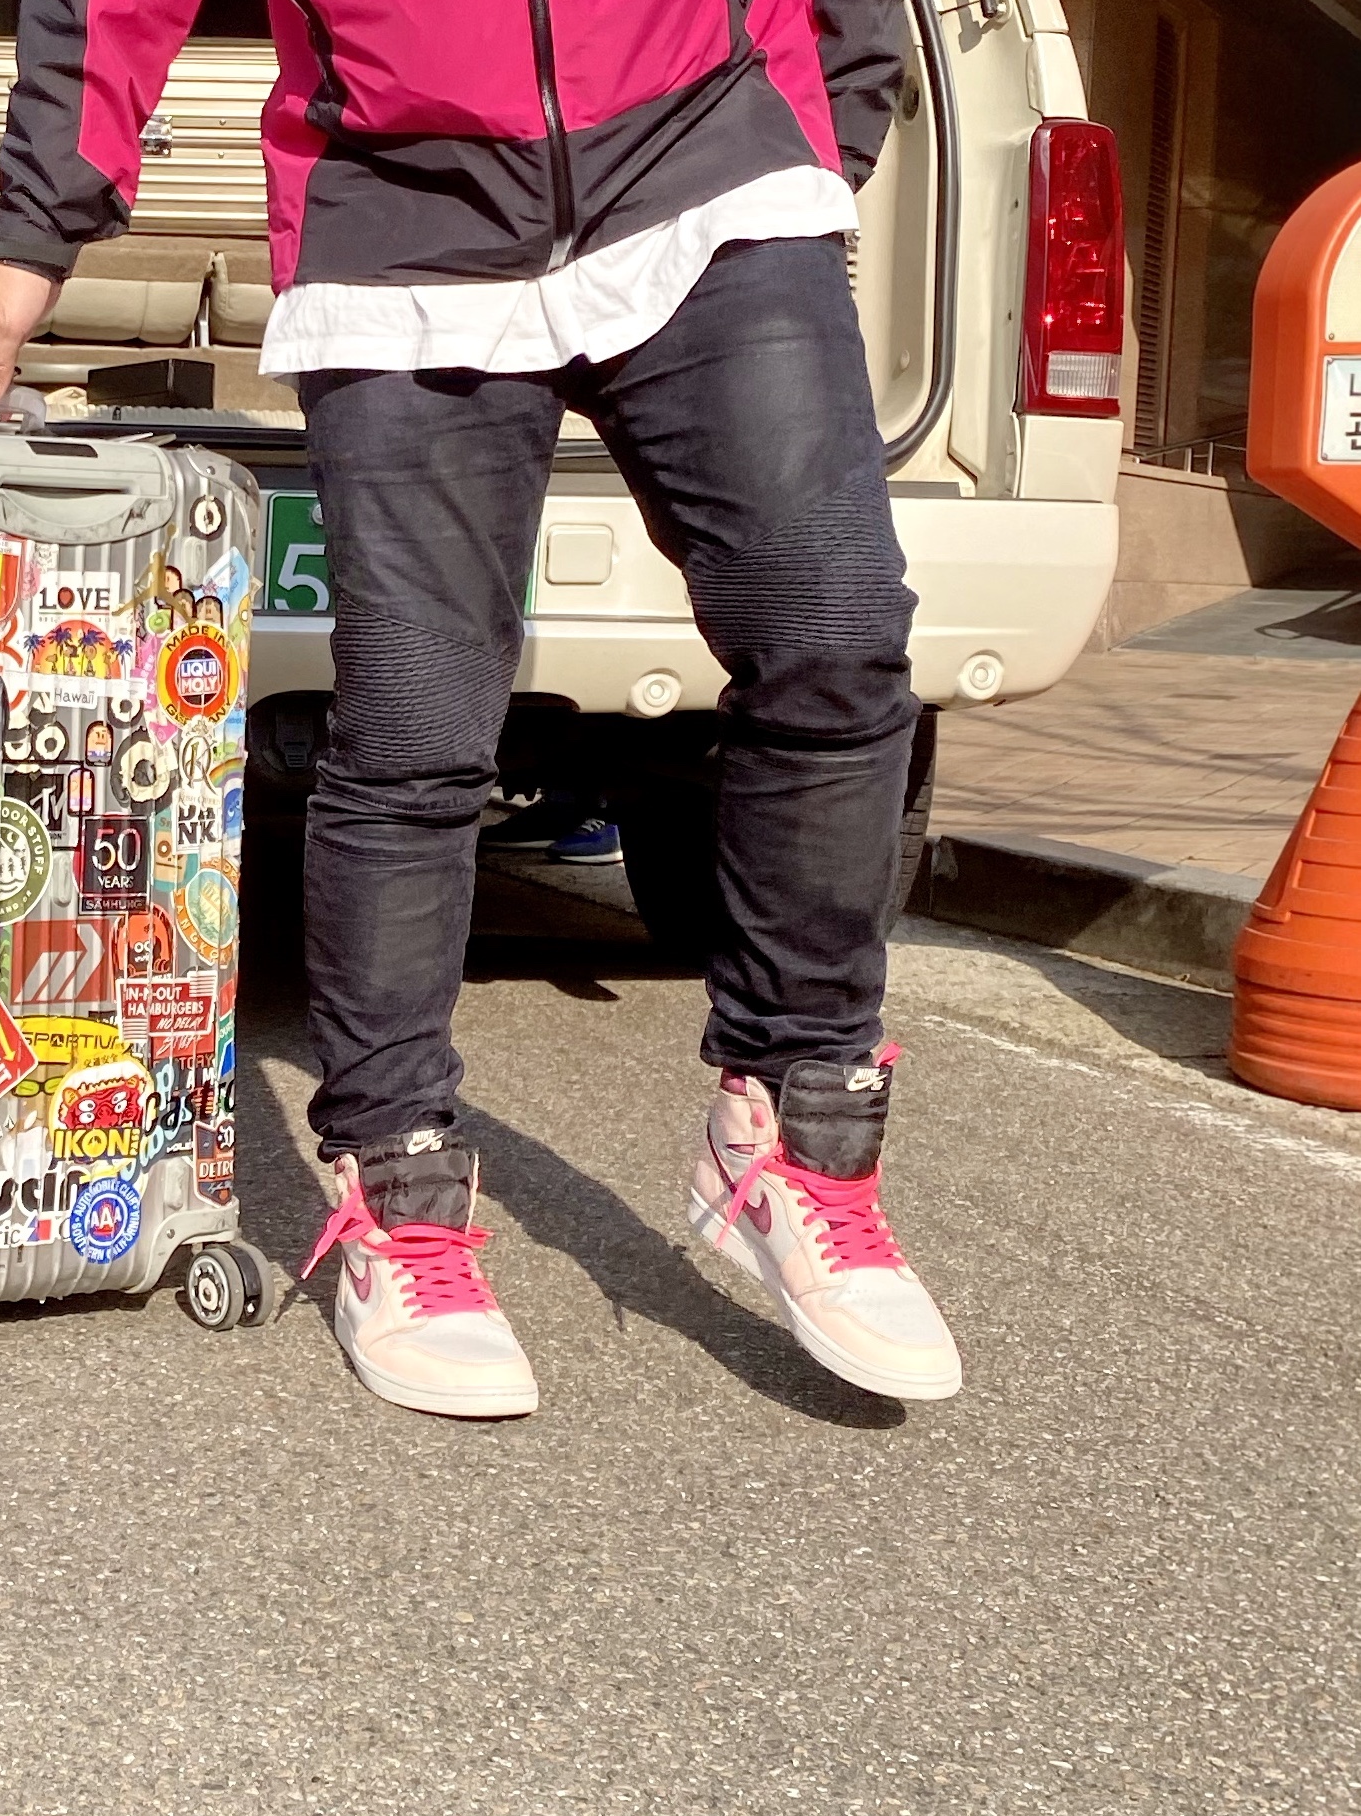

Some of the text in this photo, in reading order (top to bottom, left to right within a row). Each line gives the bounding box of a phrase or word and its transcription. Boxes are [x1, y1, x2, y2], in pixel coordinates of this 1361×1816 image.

[39, 587, 110, 610] LOVE
[166, 625, 209, 651] MADE
[180, 661, 218, 678] LIQUI
[181, 677, 218, 693] MOLY
[54, 688, 96, 706] Hawaii
[27, 826, 45, 875] STUFF
[92, 828, 142, 872] 50
[98, 875, 135, 889] YEARS
[125, 985, 182, 1001] IN-N-OUT
[128, 1001, 204, 1016] HAMBURGERS
[156, 1016, 205, 1030] NO DELAY
[854, 1068, 880, 1081] NIKE
[54, 1128, 129, 1159] IKON
[412, 1129, 436, 1144] NIKE
[73, 1179, 120, 1217] AUTOMOBILE
[91, 1205, 123, 1229] AAA
